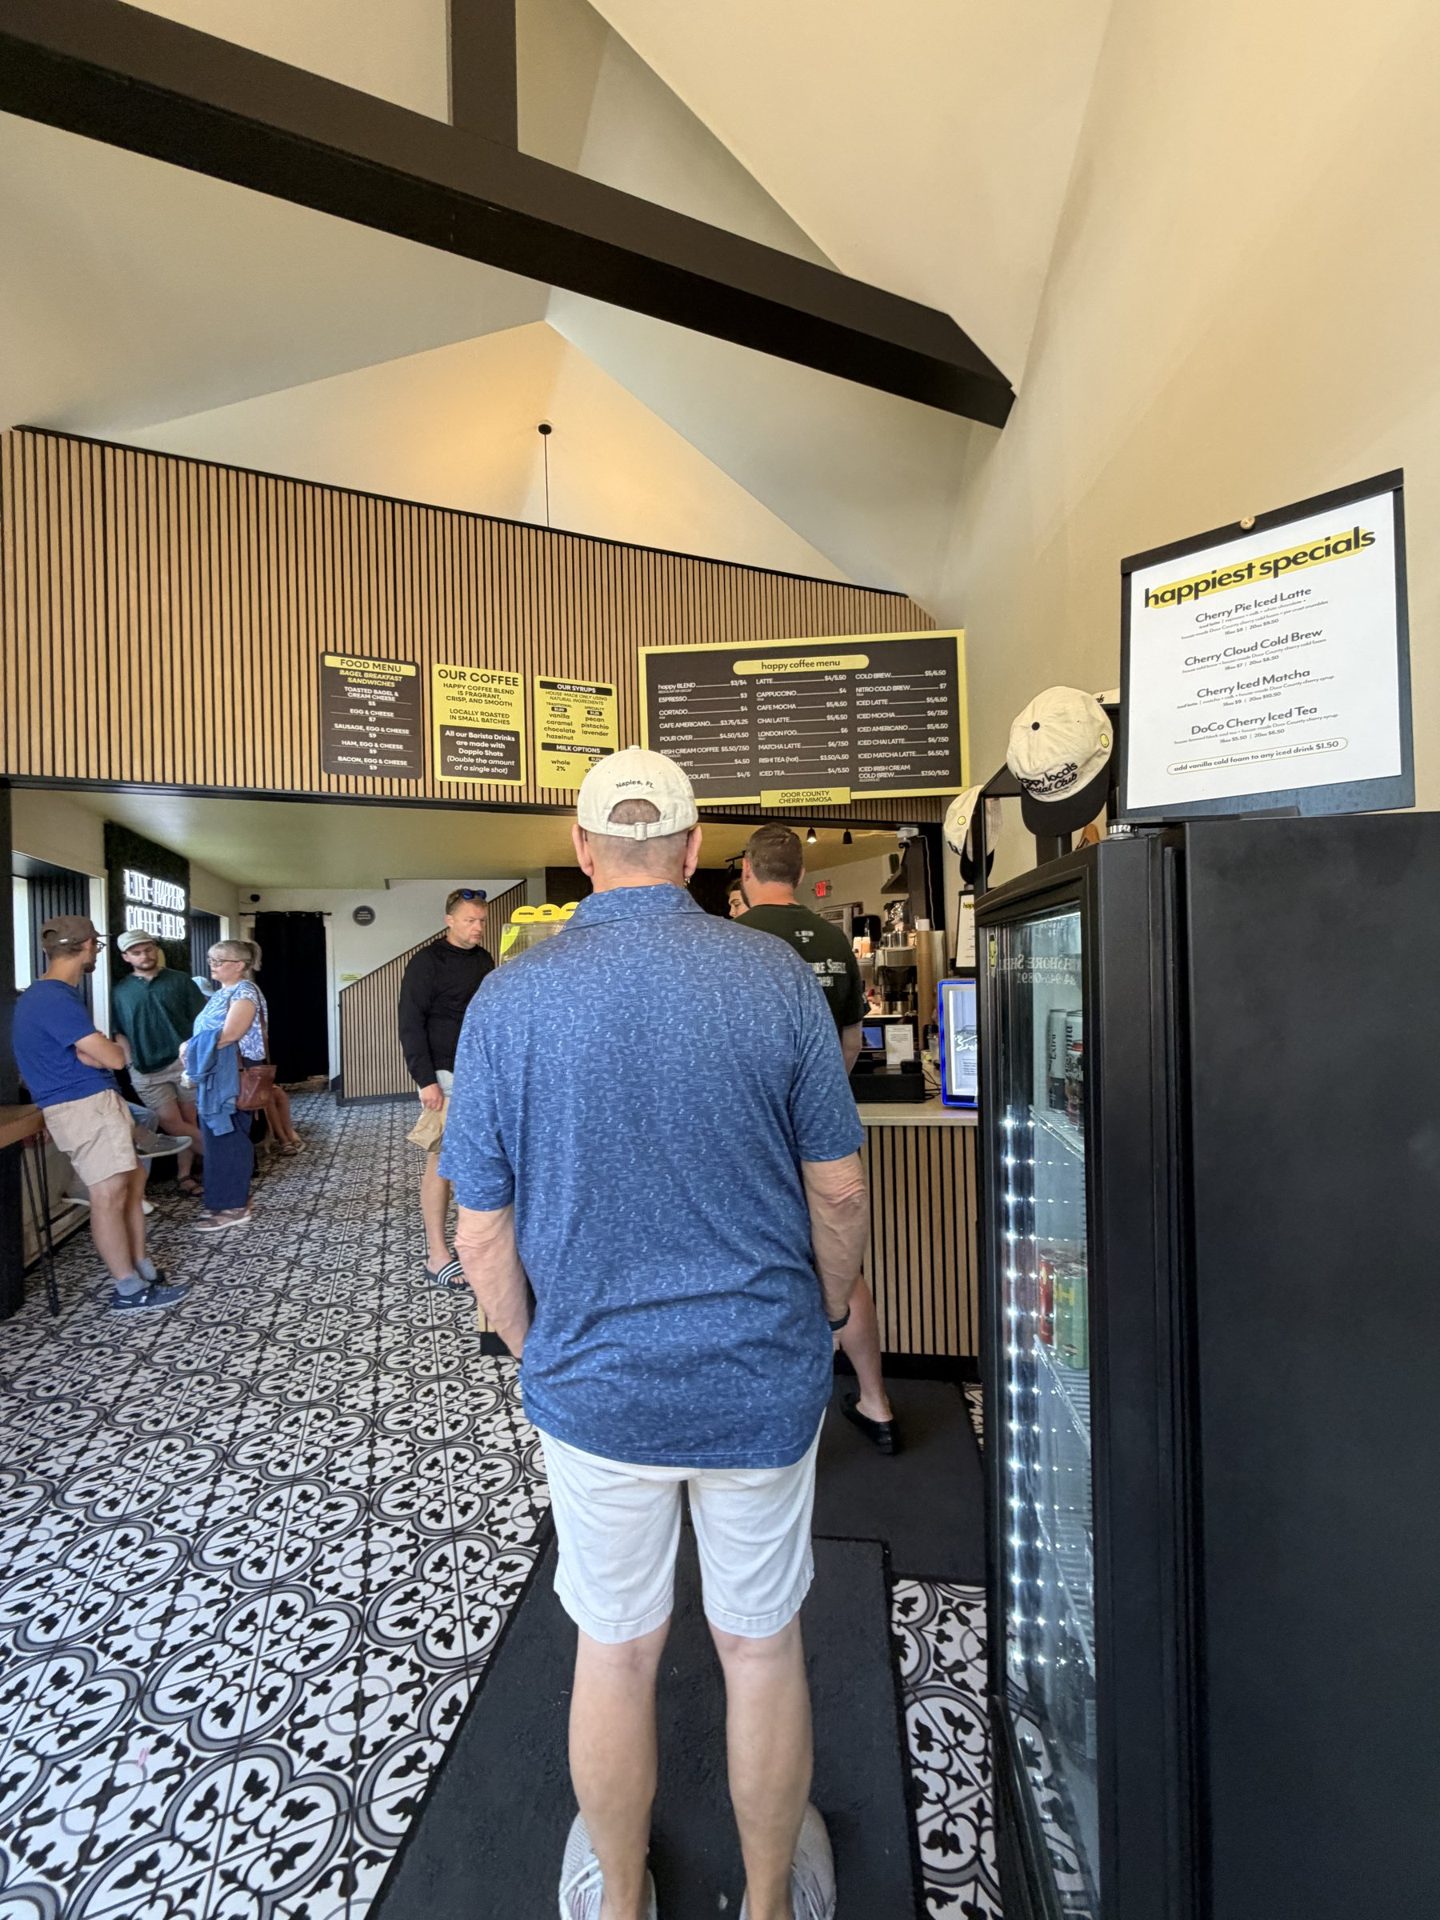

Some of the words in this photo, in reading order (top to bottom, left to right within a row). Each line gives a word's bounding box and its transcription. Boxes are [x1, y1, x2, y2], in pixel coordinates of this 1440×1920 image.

[1144, 562, 1254, 608] happiest
[1259, 526, 1375, 578] specials
[1195, 609, 1233, 623] Cherry
[1235, 603, 1251, 613] Pie
[1254, 594, 1278, 608] Iced
[1280, 588, 1312, 600] Latte
[1184, 653, 1222, 666] Cherry
[1223, 642, 1258, 657] Cloud
[1260, 635, 1288, 648] Cold
[1291, 629, 1323, 642] Brew
[340, 659, 369, 669] FOOD
[373, 663, 401, 672] MENU
[761, 662, 788, 671] happy
[347, 677, 395, 687] SANDWICHES
[364, 673, 402, 681] BREAKFAST
[438, 669, 466, 680] OUR
[470, 673, 519, 686] COFFEE
[572, 685, 596, 693] SYRUPS
[1197, 686, 1235, 698] Cherry
[1237, 678, 1260, 690] Iced
[1262, 669, 1310, 685] Matcha
[344, 686, 372, 694] TOASTED
[465, 691, 501, 700] FRAGRANT,
[484, 699, 512, 707] SMOOTH
[1191, 722, 1224, 735] DoCo
[1226, 716, 1266, 728] Cherry
[1268, 709, 1293, 721] Iced
[1294, 706, 1317, 716] Tea
[469, 732, 492, 740] Barista
[458, 748, 483, 756] Doppio
[1174, 764, 1188, 772] add
[1189, 760, 1212, 769] vanilla
[1214, 758, 1229, 766] cold
[1230, 755, 1250, 763] foam
[1294, 745, 1314, 754] drink
[1315, 741, 1339, 750] $1.50
[1044, 763, 1078, 781] locals
[616, 780, 643, 788] Naples,
[1055, 772, 1077, 788] Club
